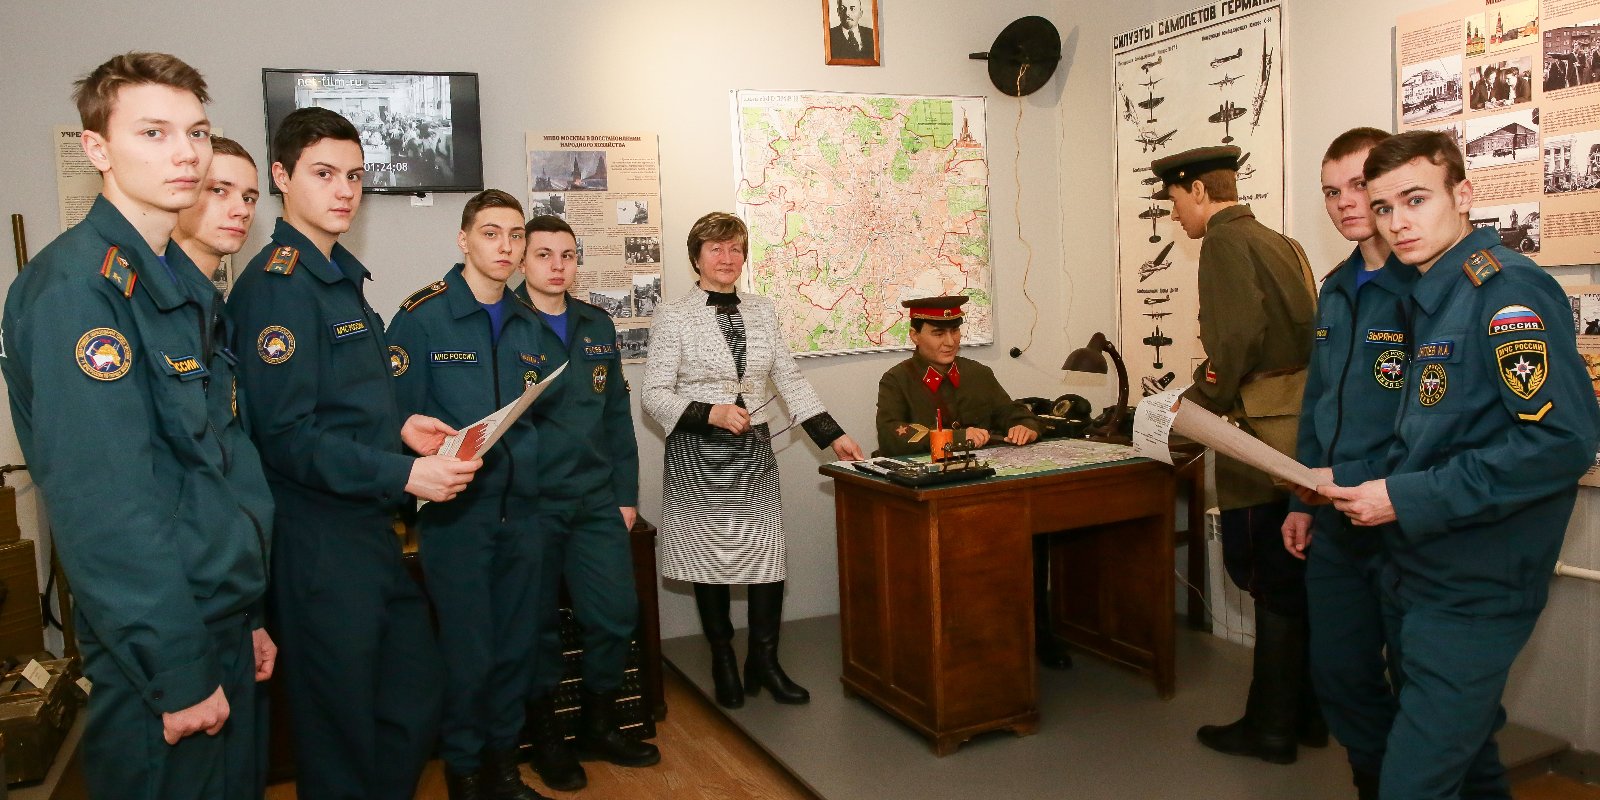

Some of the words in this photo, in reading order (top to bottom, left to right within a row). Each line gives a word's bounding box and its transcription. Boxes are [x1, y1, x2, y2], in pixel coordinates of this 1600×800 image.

[1113, 25, 1154, 49] СИЛУЭТЫ
[1158, 5, 1217, 36] САМОЛЕТОВ
[1221, 0, 1277, 16] ГЕРМА
[1494, 322, 1539, 332] РОССИЯ
[1368, 331, 1404, 343] ЗЫРЯНОВ
[1498, 345, 1513, 356] МЧС
[1515, 342, 1543, 351] РОССИИ
[434, 352, 449, 361] МЧС
[450, 352, 475, 360] РОССИИ
